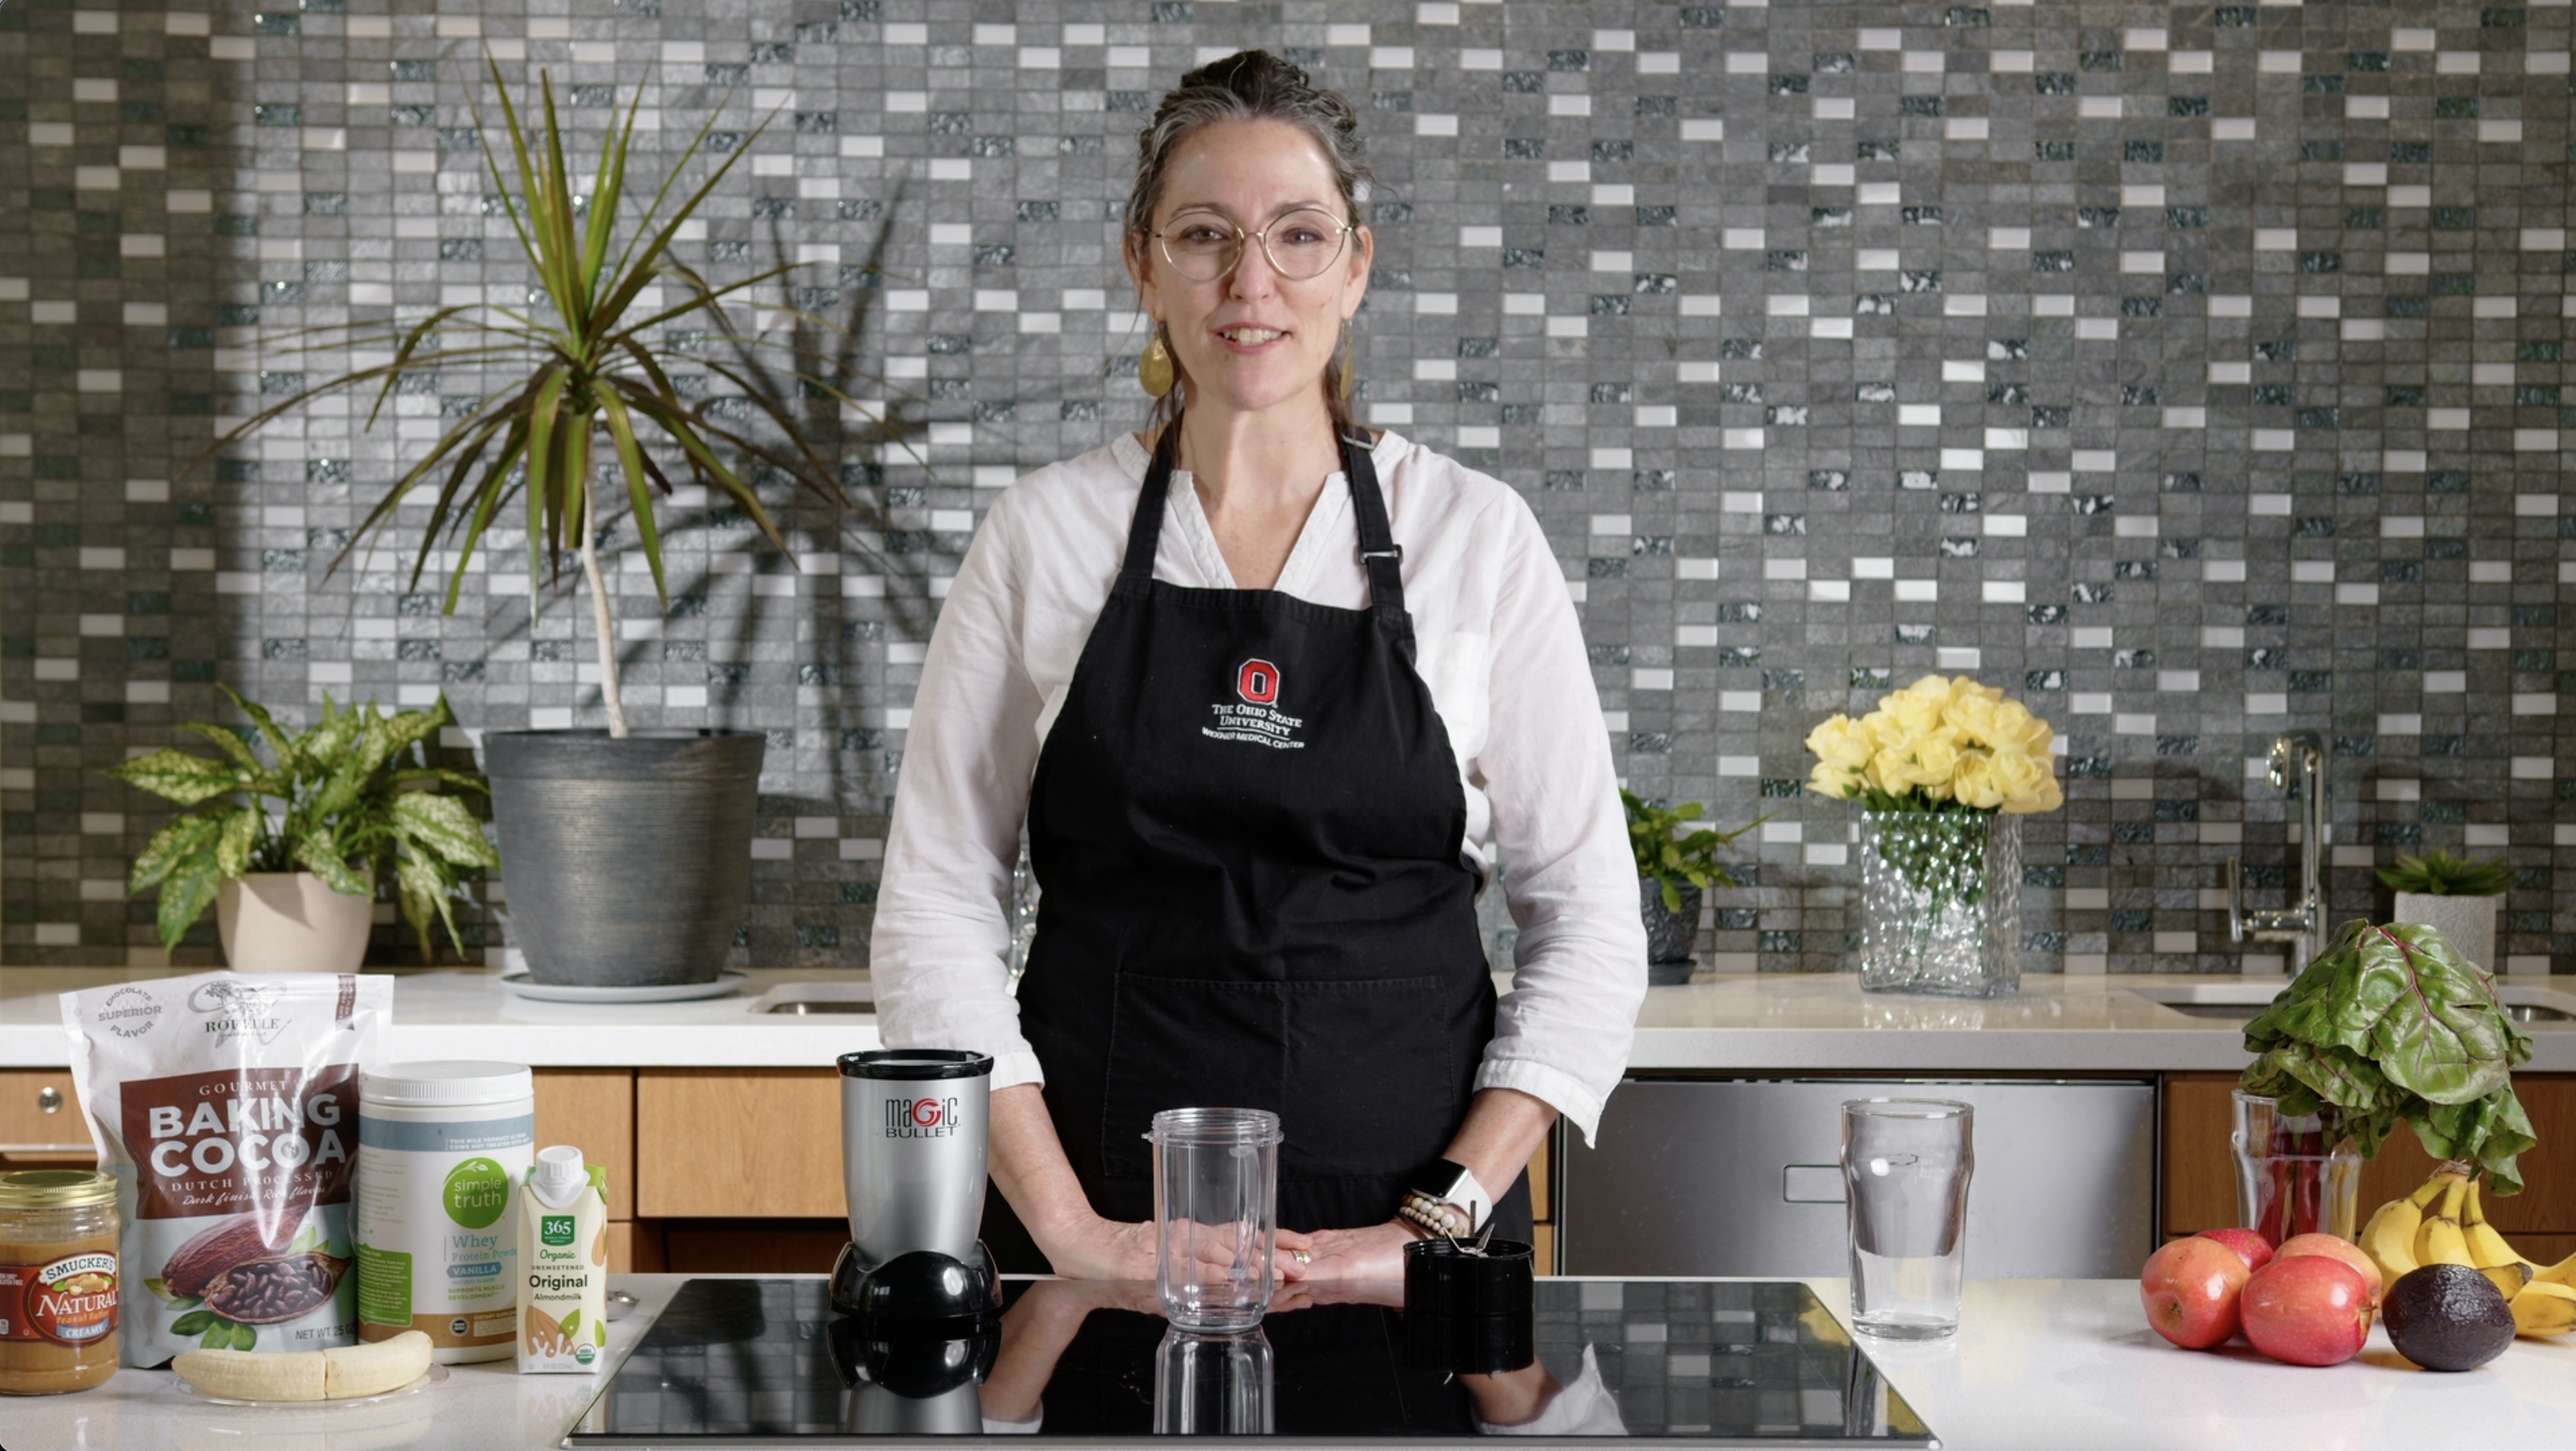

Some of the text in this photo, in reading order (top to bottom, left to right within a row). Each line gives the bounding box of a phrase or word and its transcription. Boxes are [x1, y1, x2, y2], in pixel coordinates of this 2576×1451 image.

[1237, 658, 1280, 705] O
[1212, 704, 1303, 728] THE OHIO STATE
[1220, 715, 1291, 736] UNIVERSITY
[1236, 732, 1272, 746] MEDICAL
[1272, 740, 1305, 750] CENTER
[106, 987, 152, 1008] CHOCOLATE
[98, 1005, 163, 1023] SUPERIOR
[110, 1020, 155, 1039] FLAVOR
[199, 1079, 288, 1096] GOURMET
[149, 1093, 341, 1139] BAKING
[885, 1126, 955, 1138] BULLET
[150, 1128, 346, 1177] COCOA
[171, 1170, 333, 1193] DUTCH PROCESSED
[453, 1177, 502, 1193] simple
[181, 1191, 213, 1206] Dark
[453, 1191, 502, 1208] truth
[544, 1219, 572, 1236] 365
[452, 1234, 499, 1250] Whey
[452, 1251, 490, 1261] Protein
[540, 1248, 576, 1263] Organic
[46, 1257, 114, 1281] SMUCKER'S
[453, 1264, 498, 1276] VANILLA
[529, 1274, 588, 1291] Original
[36, 1290, 117, 1317] NATURAL
[57, 1313, 87, 1324] Peanut
[66, 1323, 103, 1337] CREAMY
[296, 1328, 314, 1340] NET
[317, 1327, 331, 1338] WT
[333, 1325, 344, 1337] 25
